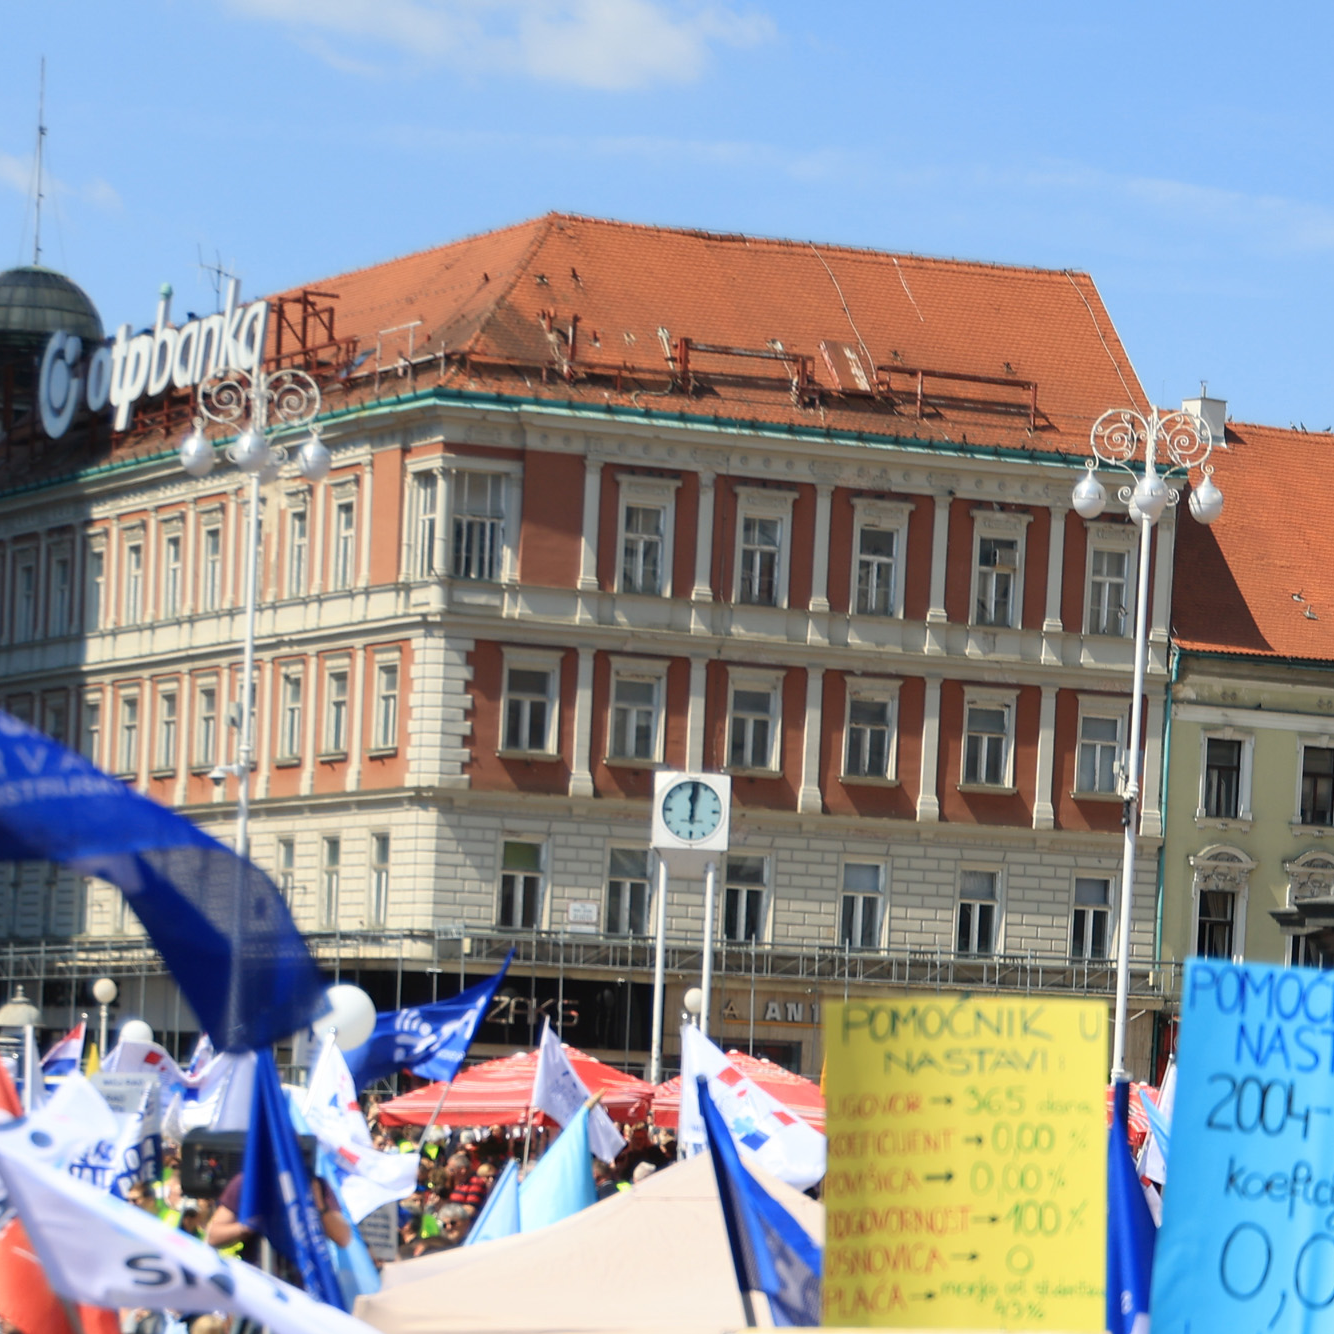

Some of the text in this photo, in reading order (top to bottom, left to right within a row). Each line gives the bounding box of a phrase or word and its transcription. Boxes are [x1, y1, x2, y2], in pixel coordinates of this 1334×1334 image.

[841, 992, 1103, 1046] POMOĆNIK U
[964, 1085, 1028, 1116] 365
